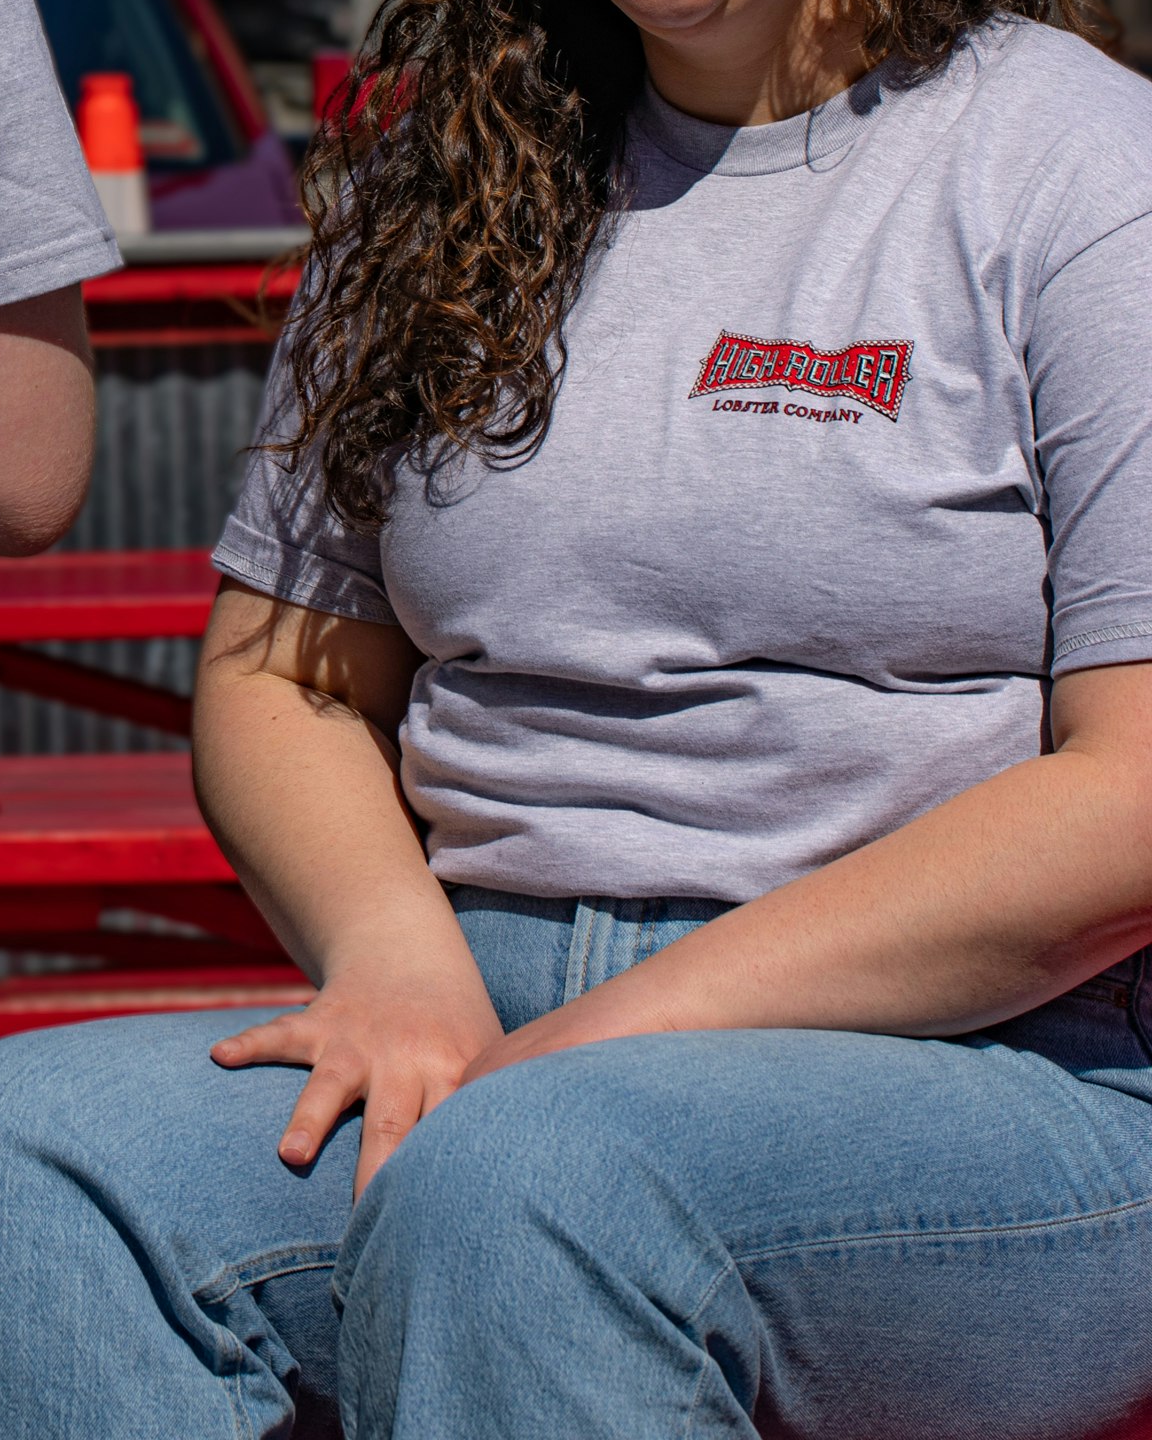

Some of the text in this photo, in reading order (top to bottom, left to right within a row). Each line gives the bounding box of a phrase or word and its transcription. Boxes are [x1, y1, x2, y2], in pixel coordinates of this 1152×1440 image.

[706, 341, 899, 403] HIGH ROLLER
[712, 399, 863, 424] LOBSTER COMPANY
